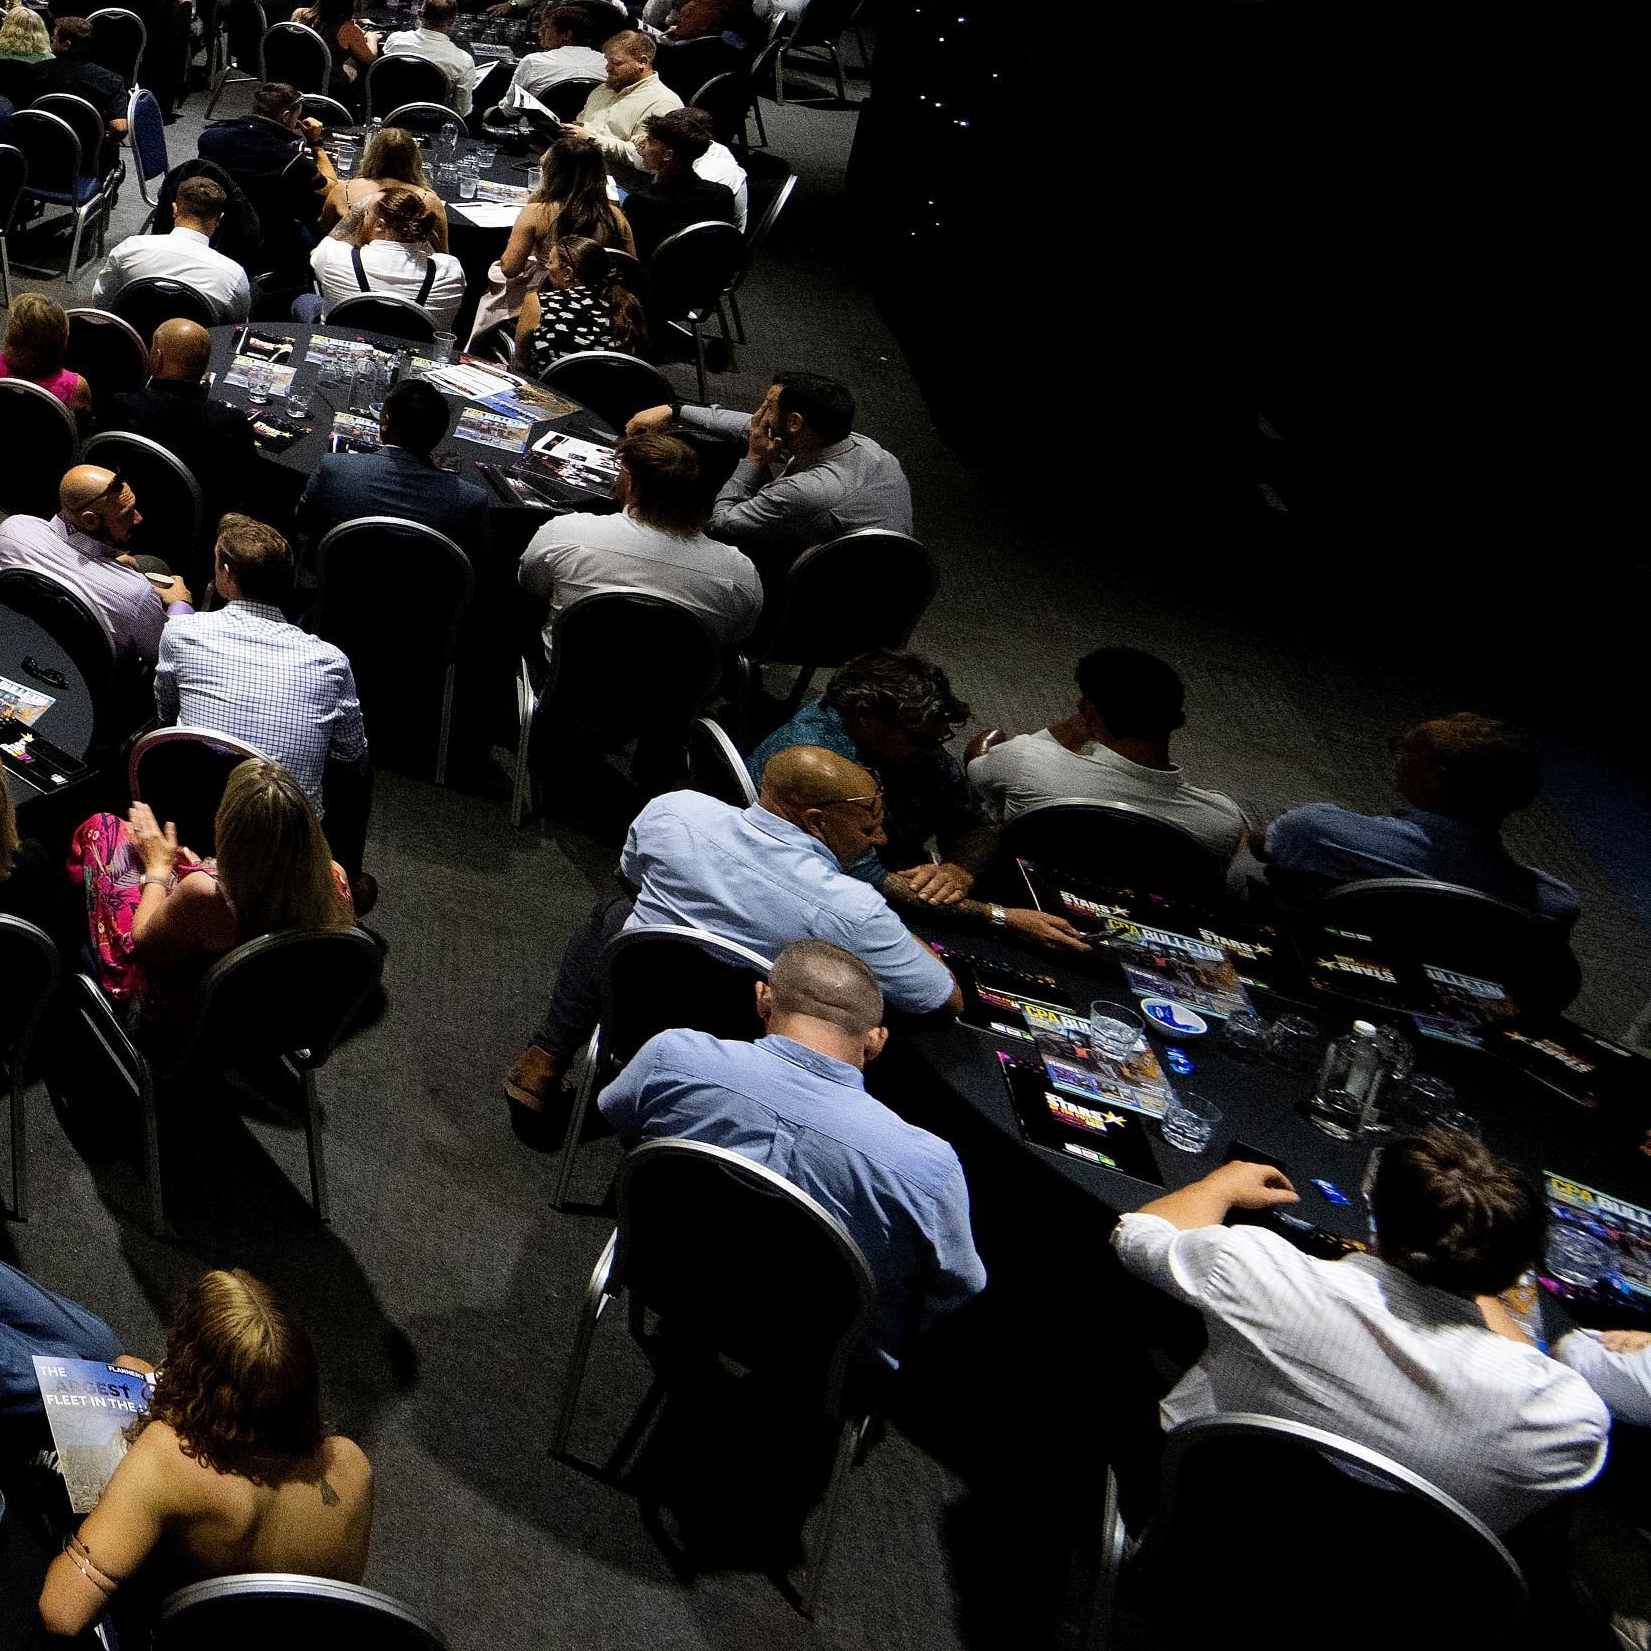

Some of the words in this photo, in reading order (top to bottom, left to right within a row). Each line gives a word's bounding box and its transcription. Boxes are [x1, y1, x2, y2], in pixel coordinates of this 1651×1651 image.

[1141, 928, 1225, 962] BULLETIN
[1025, 1004, 1059, 1023] CPA
[37, 1365, 67, 1378] THE
[107, 1365, 145, 1380] FLANNERY
[45, 1394, 87, 1406] FLEET
[90, 1396, 107, 1408] IN
[108, 1399, 138, 1413] THE
